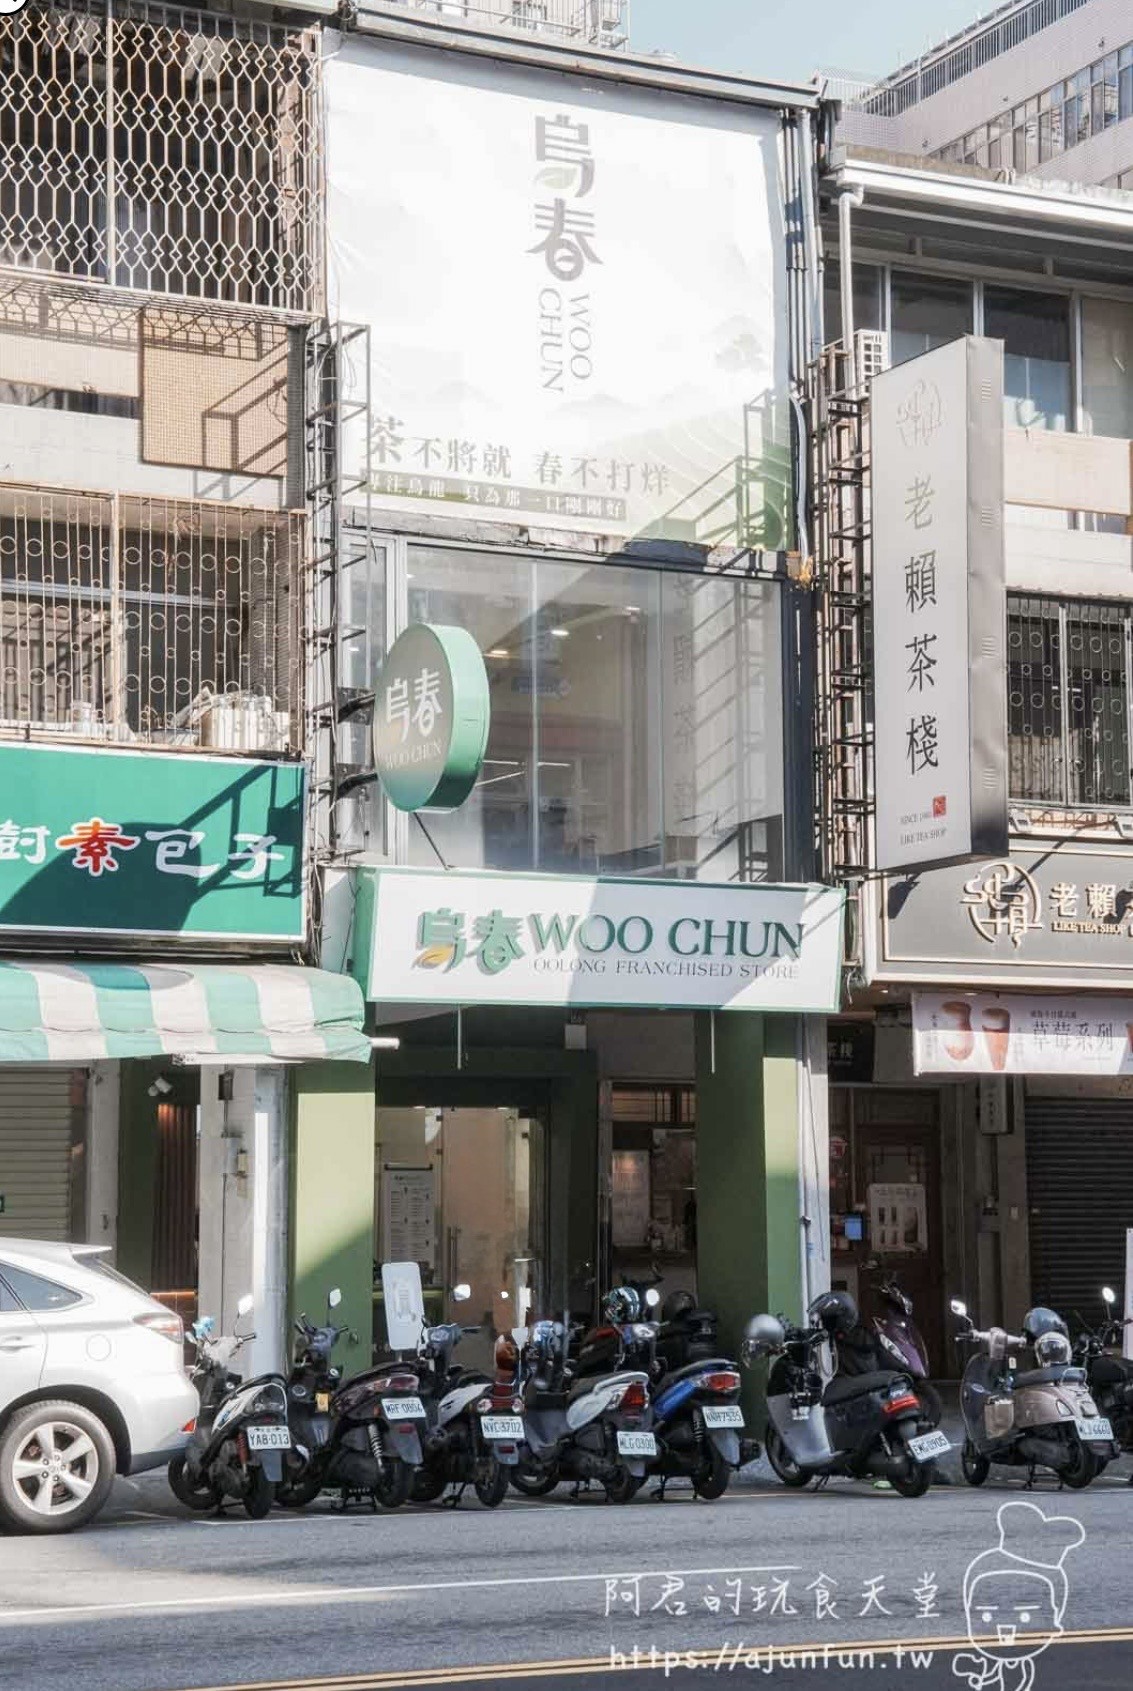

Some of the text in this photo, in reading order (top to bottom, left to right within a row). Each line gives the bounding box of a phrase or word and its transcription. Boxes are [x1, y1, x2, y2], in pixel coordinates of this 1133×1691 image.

[538, 287, 564, 393] CHUN
[569, 291, 593, 381] WOO
[362, 416, 671, 496] 茶不將就 春不打烊
[903, 473, 939, 778] 老賴茶棧
[528, 911, 653, 955] WOO
[668, 916, 806, 960] CHUN
[1050, 882, 1133, 919] 老賴
[534, 958, 799, 979] OOLONG FRANCHISED STORE
